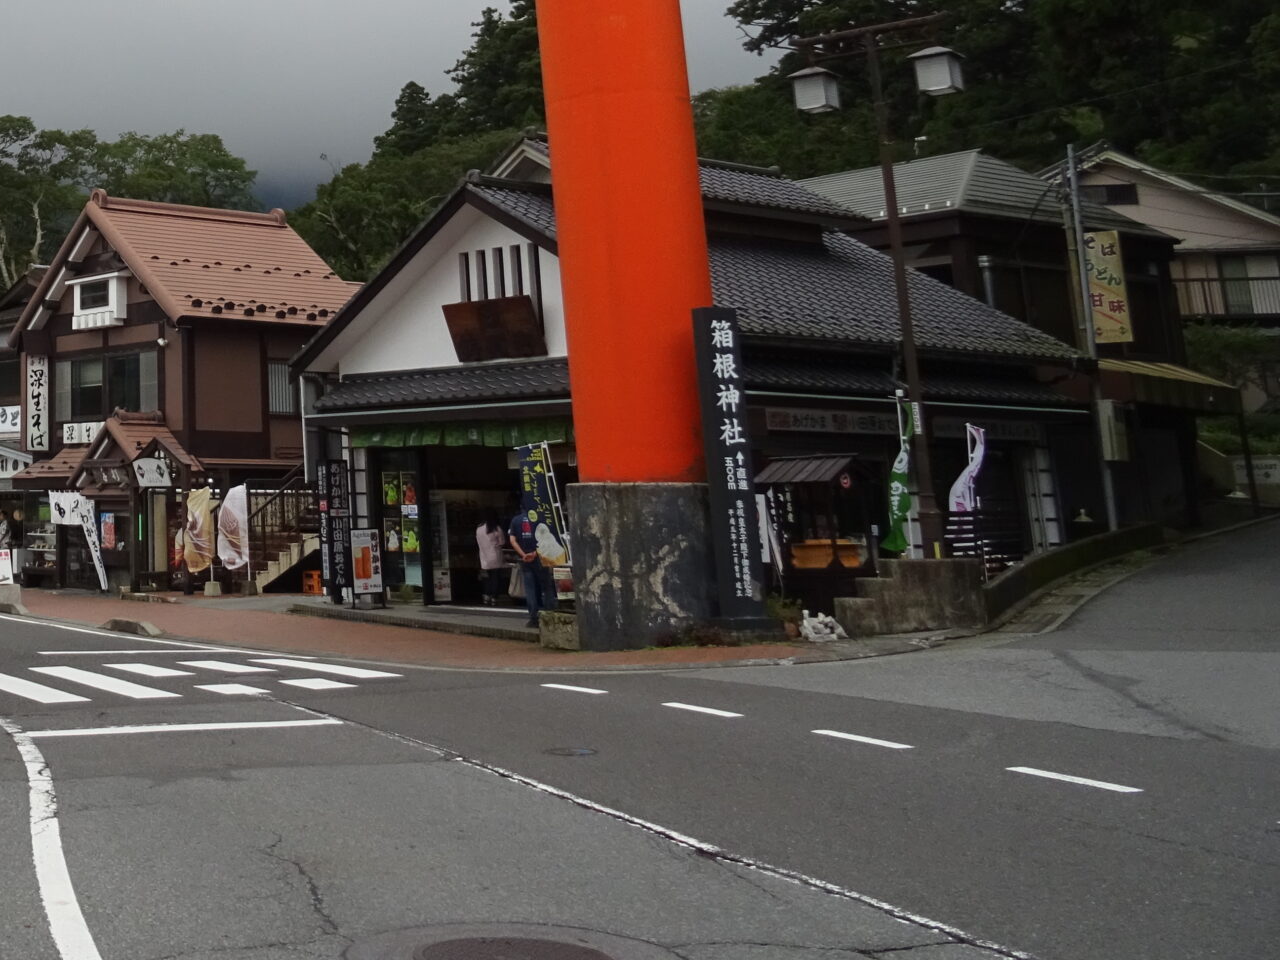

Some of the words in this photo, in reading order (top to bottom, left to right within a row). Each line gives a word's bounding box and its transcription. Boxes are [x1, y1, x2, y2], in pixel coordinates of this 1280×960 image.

[1089, 293, 1126, 314] 甘味
[711, 320, 746, 446] 箱根神社
[736, 467, 749, 490] 直進
[332, 518, 345, 585] 小田原おでん
[370, 531, 380, 575] あげかま
